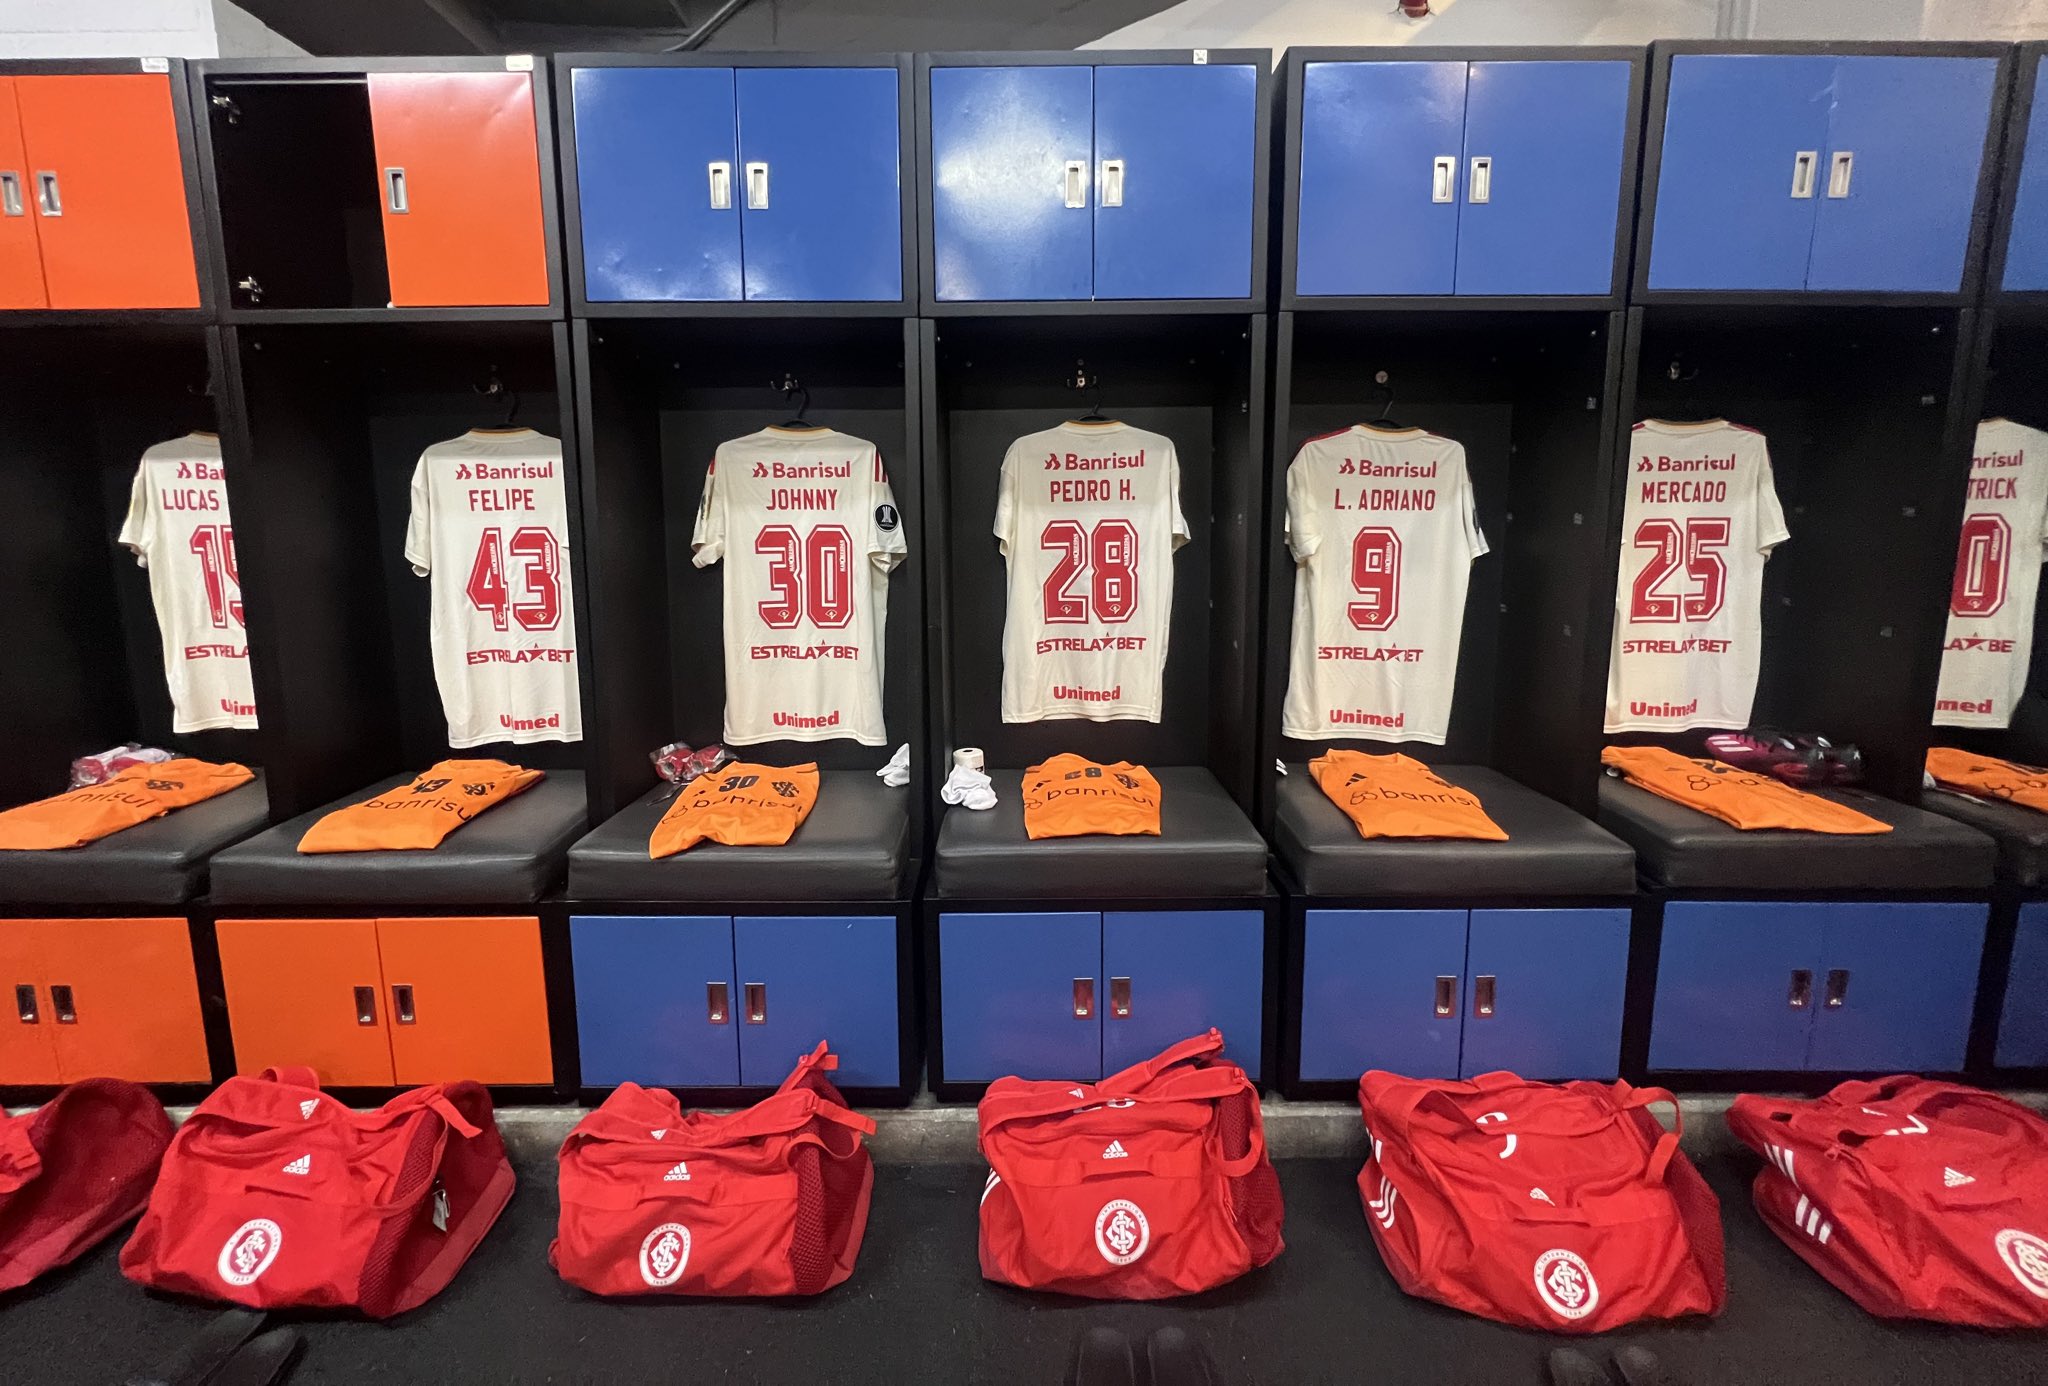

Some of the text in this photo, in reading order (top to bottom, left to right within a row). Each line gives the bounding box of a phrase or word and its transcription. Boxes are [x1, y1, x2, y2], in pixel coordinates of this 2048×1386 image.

[476, 461, 553, 480] Banrisul
[772, 461, 850, 478] Banrisul
[1065, 450, 1144, 471] Banrisul
[1359, 459, 1437, 478] Banrisul
[162, 488, 220, 511] LUCAS
[468, 488, 535, 511] FELIPE
[766, 489, 837, 511] JOHNNY
[1051, 478, 1136, 502] PEDRO H.
[1334, 488, 1436, 511] L. ADRIANO
[1641, 481, 1727, 503] MERCADO
[466, 526, 562, 632] 43
[755, 524, 854, 630] 30
[1041, 518, 1139, 624] 28
[1347, 526, 1402, 632] 9
[1630, 517, 1731, 624] 25
[1053, 685, 1120, 702] Unimed
[773, 710, 840, 729] Unimed
[1330, 708, 1404, 729] Unimed
[718, 775, 761, 793] 30
